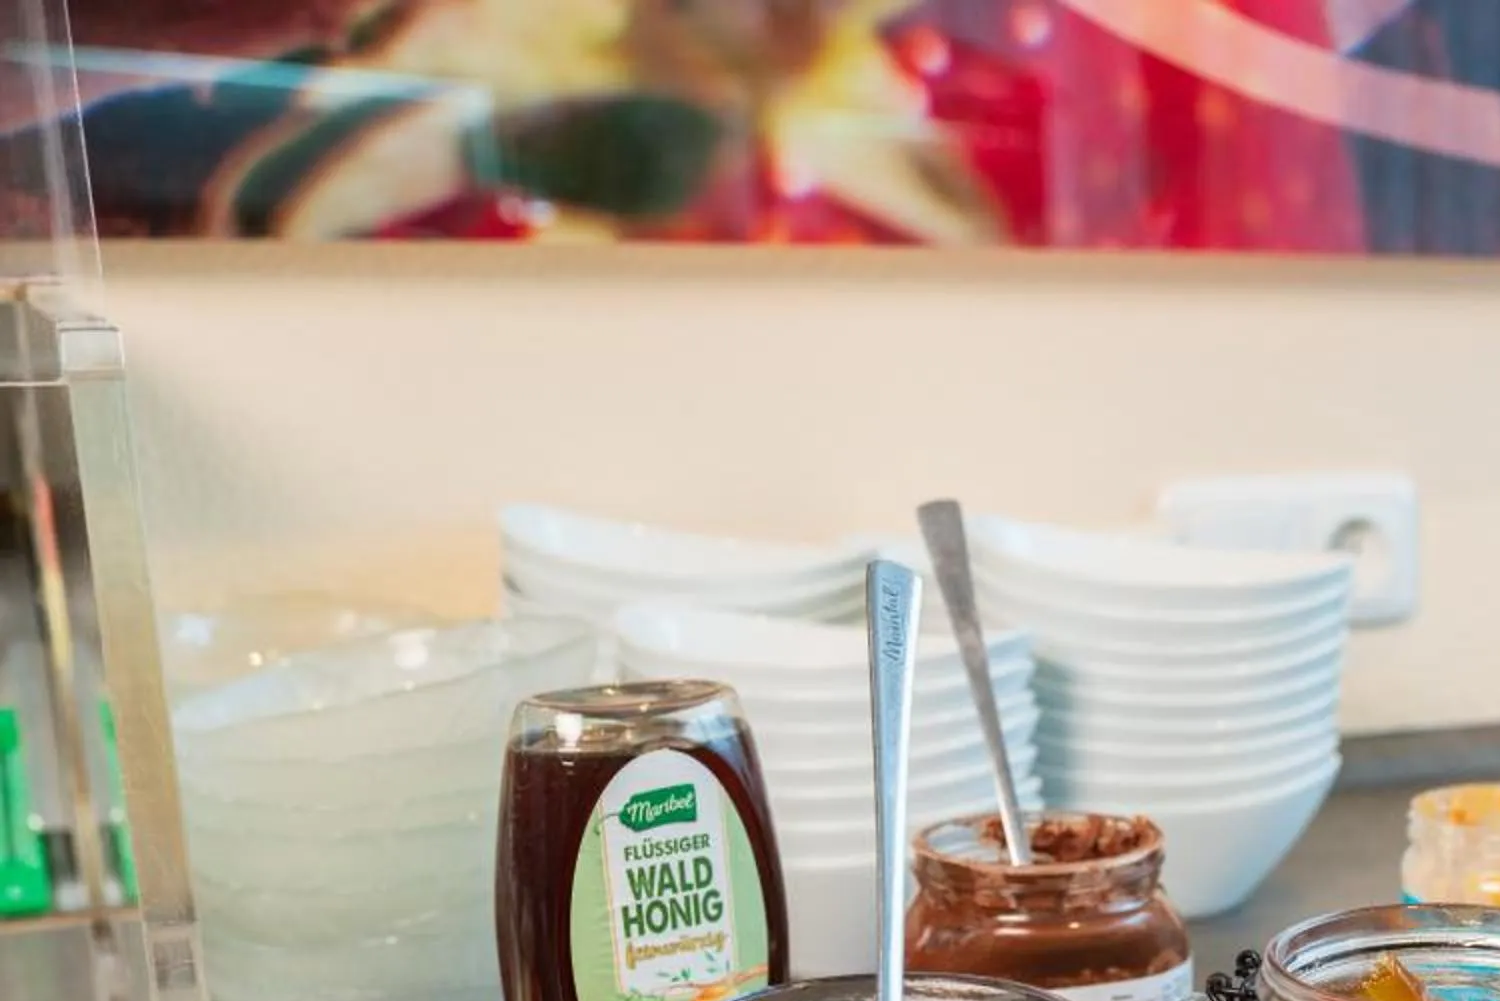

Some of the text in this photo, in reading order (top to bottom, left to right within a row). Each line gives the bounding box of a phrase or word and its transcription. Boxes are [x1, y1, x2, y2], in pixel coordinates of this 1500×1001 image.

[627, 794, 694, 823] Maribel
[624, 833, 711, 862] FLÜSSIGER
[625, 855, 713, 901] WALD
[621, 889, 724, 938] HONIG
